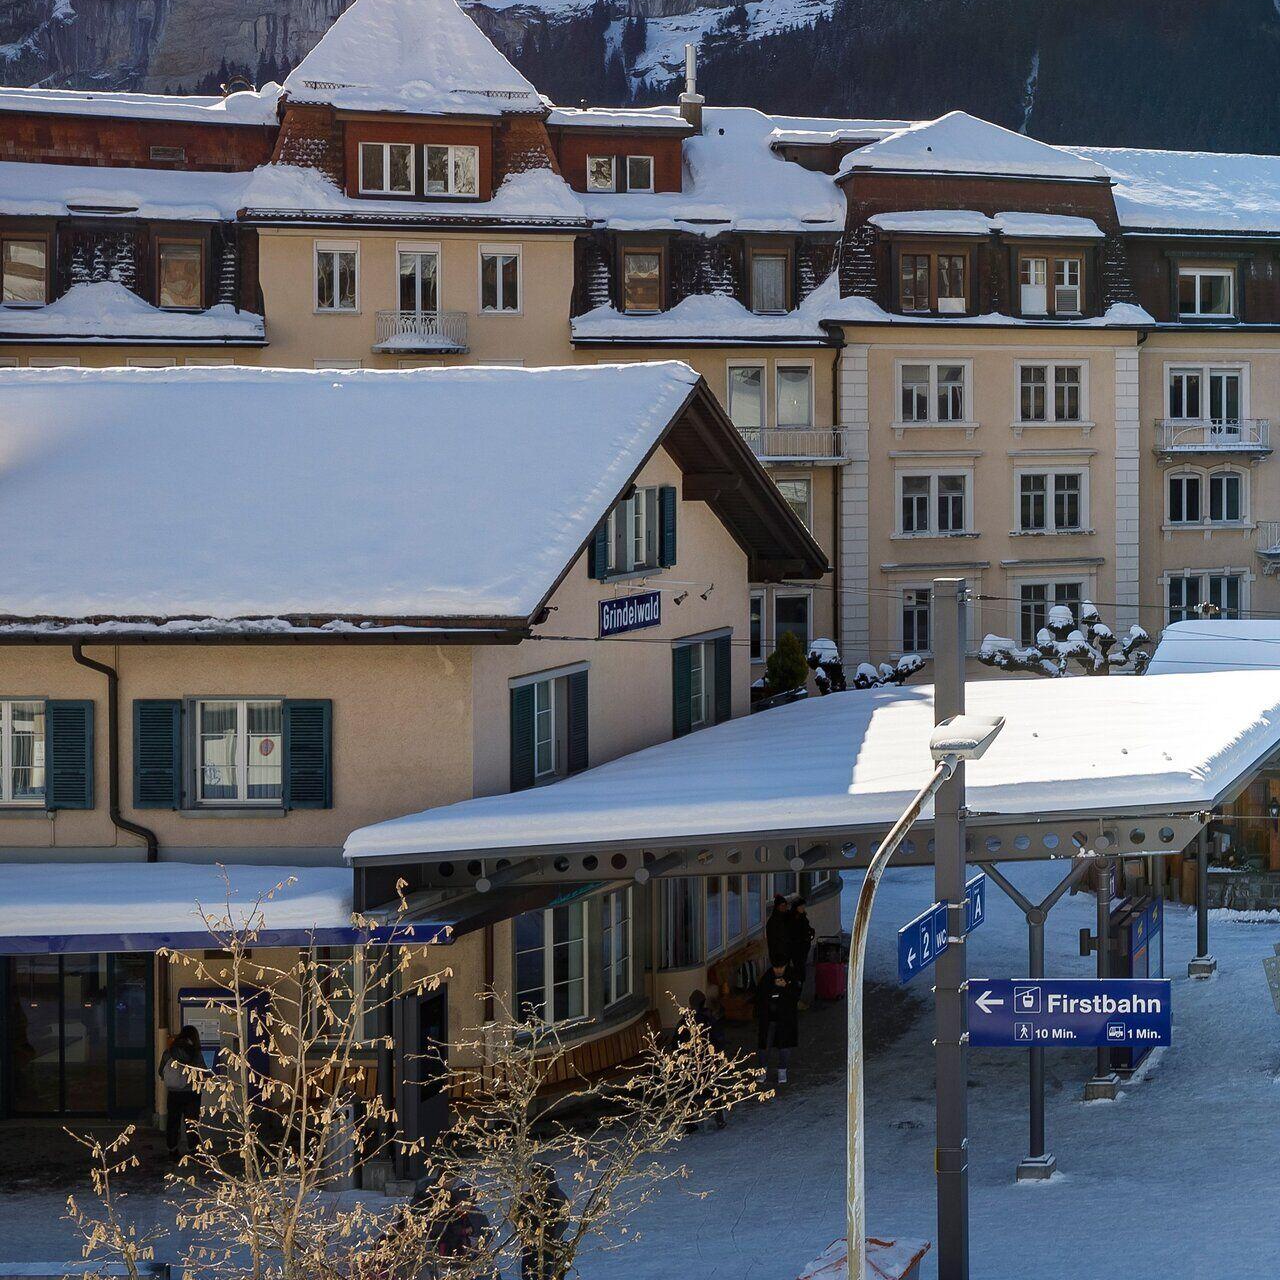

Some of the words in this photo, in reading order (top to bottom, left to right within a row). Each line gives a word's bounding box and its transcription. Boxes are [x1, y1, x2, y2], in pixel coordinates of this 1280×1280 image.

[603, 595, 659, 630] Grindelwald
[974, 894, 982, 920] A
[923, 932, 930, 959] 2
[936, 928, 947, 949] WC
[1047, 994, 1162, 1013] Firstbahn
[1035, 1029, 1048, 1039] 10
[1052, 1028, 1077, 1039] Min.
[1127, 1029, 1133, 1039] 1
[1136, 1028, 1162, 1039] Min.
